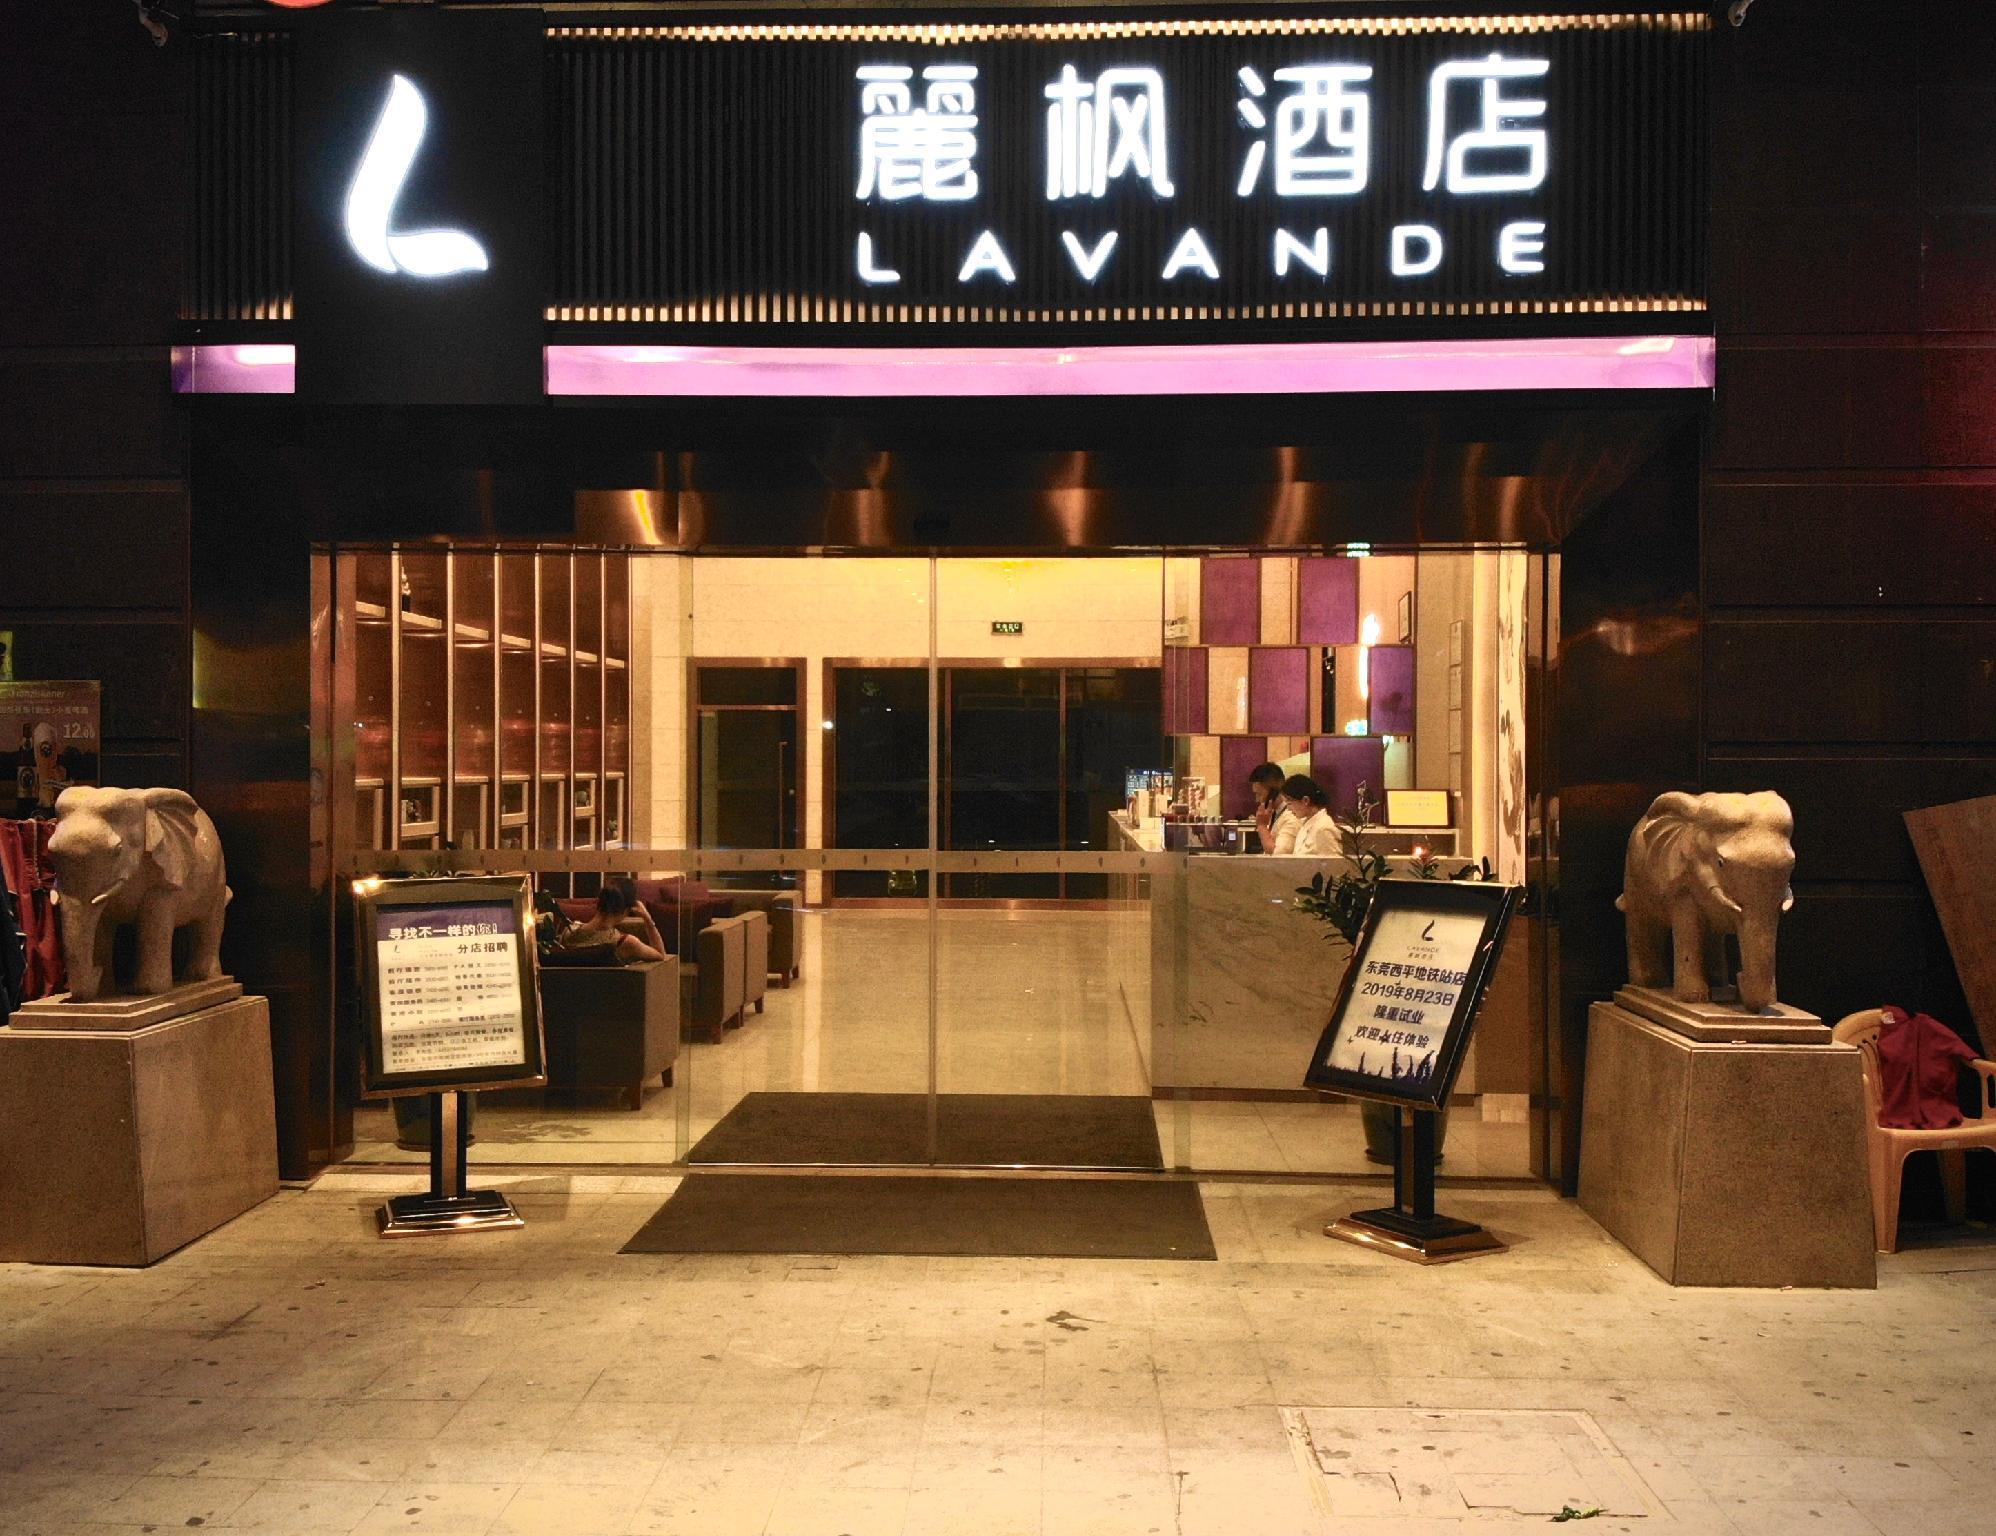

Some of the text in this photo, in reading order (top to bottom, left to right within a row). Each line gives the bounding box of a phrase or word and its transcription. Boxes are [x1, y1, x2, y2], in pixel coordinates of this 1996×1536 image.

[857, 54, 1548, 200] 麗枫酒店
[858, 222, 1545, 282] LAVANDE
[457, 941, 509, 954] 分店招聘
[1365, 960, 1468, 986] 东莞西平地铁站店
[1361, 982, 1455, 1007] 2019年8月23日
[1373, 1004, 1425, 1025] 隆重试业
